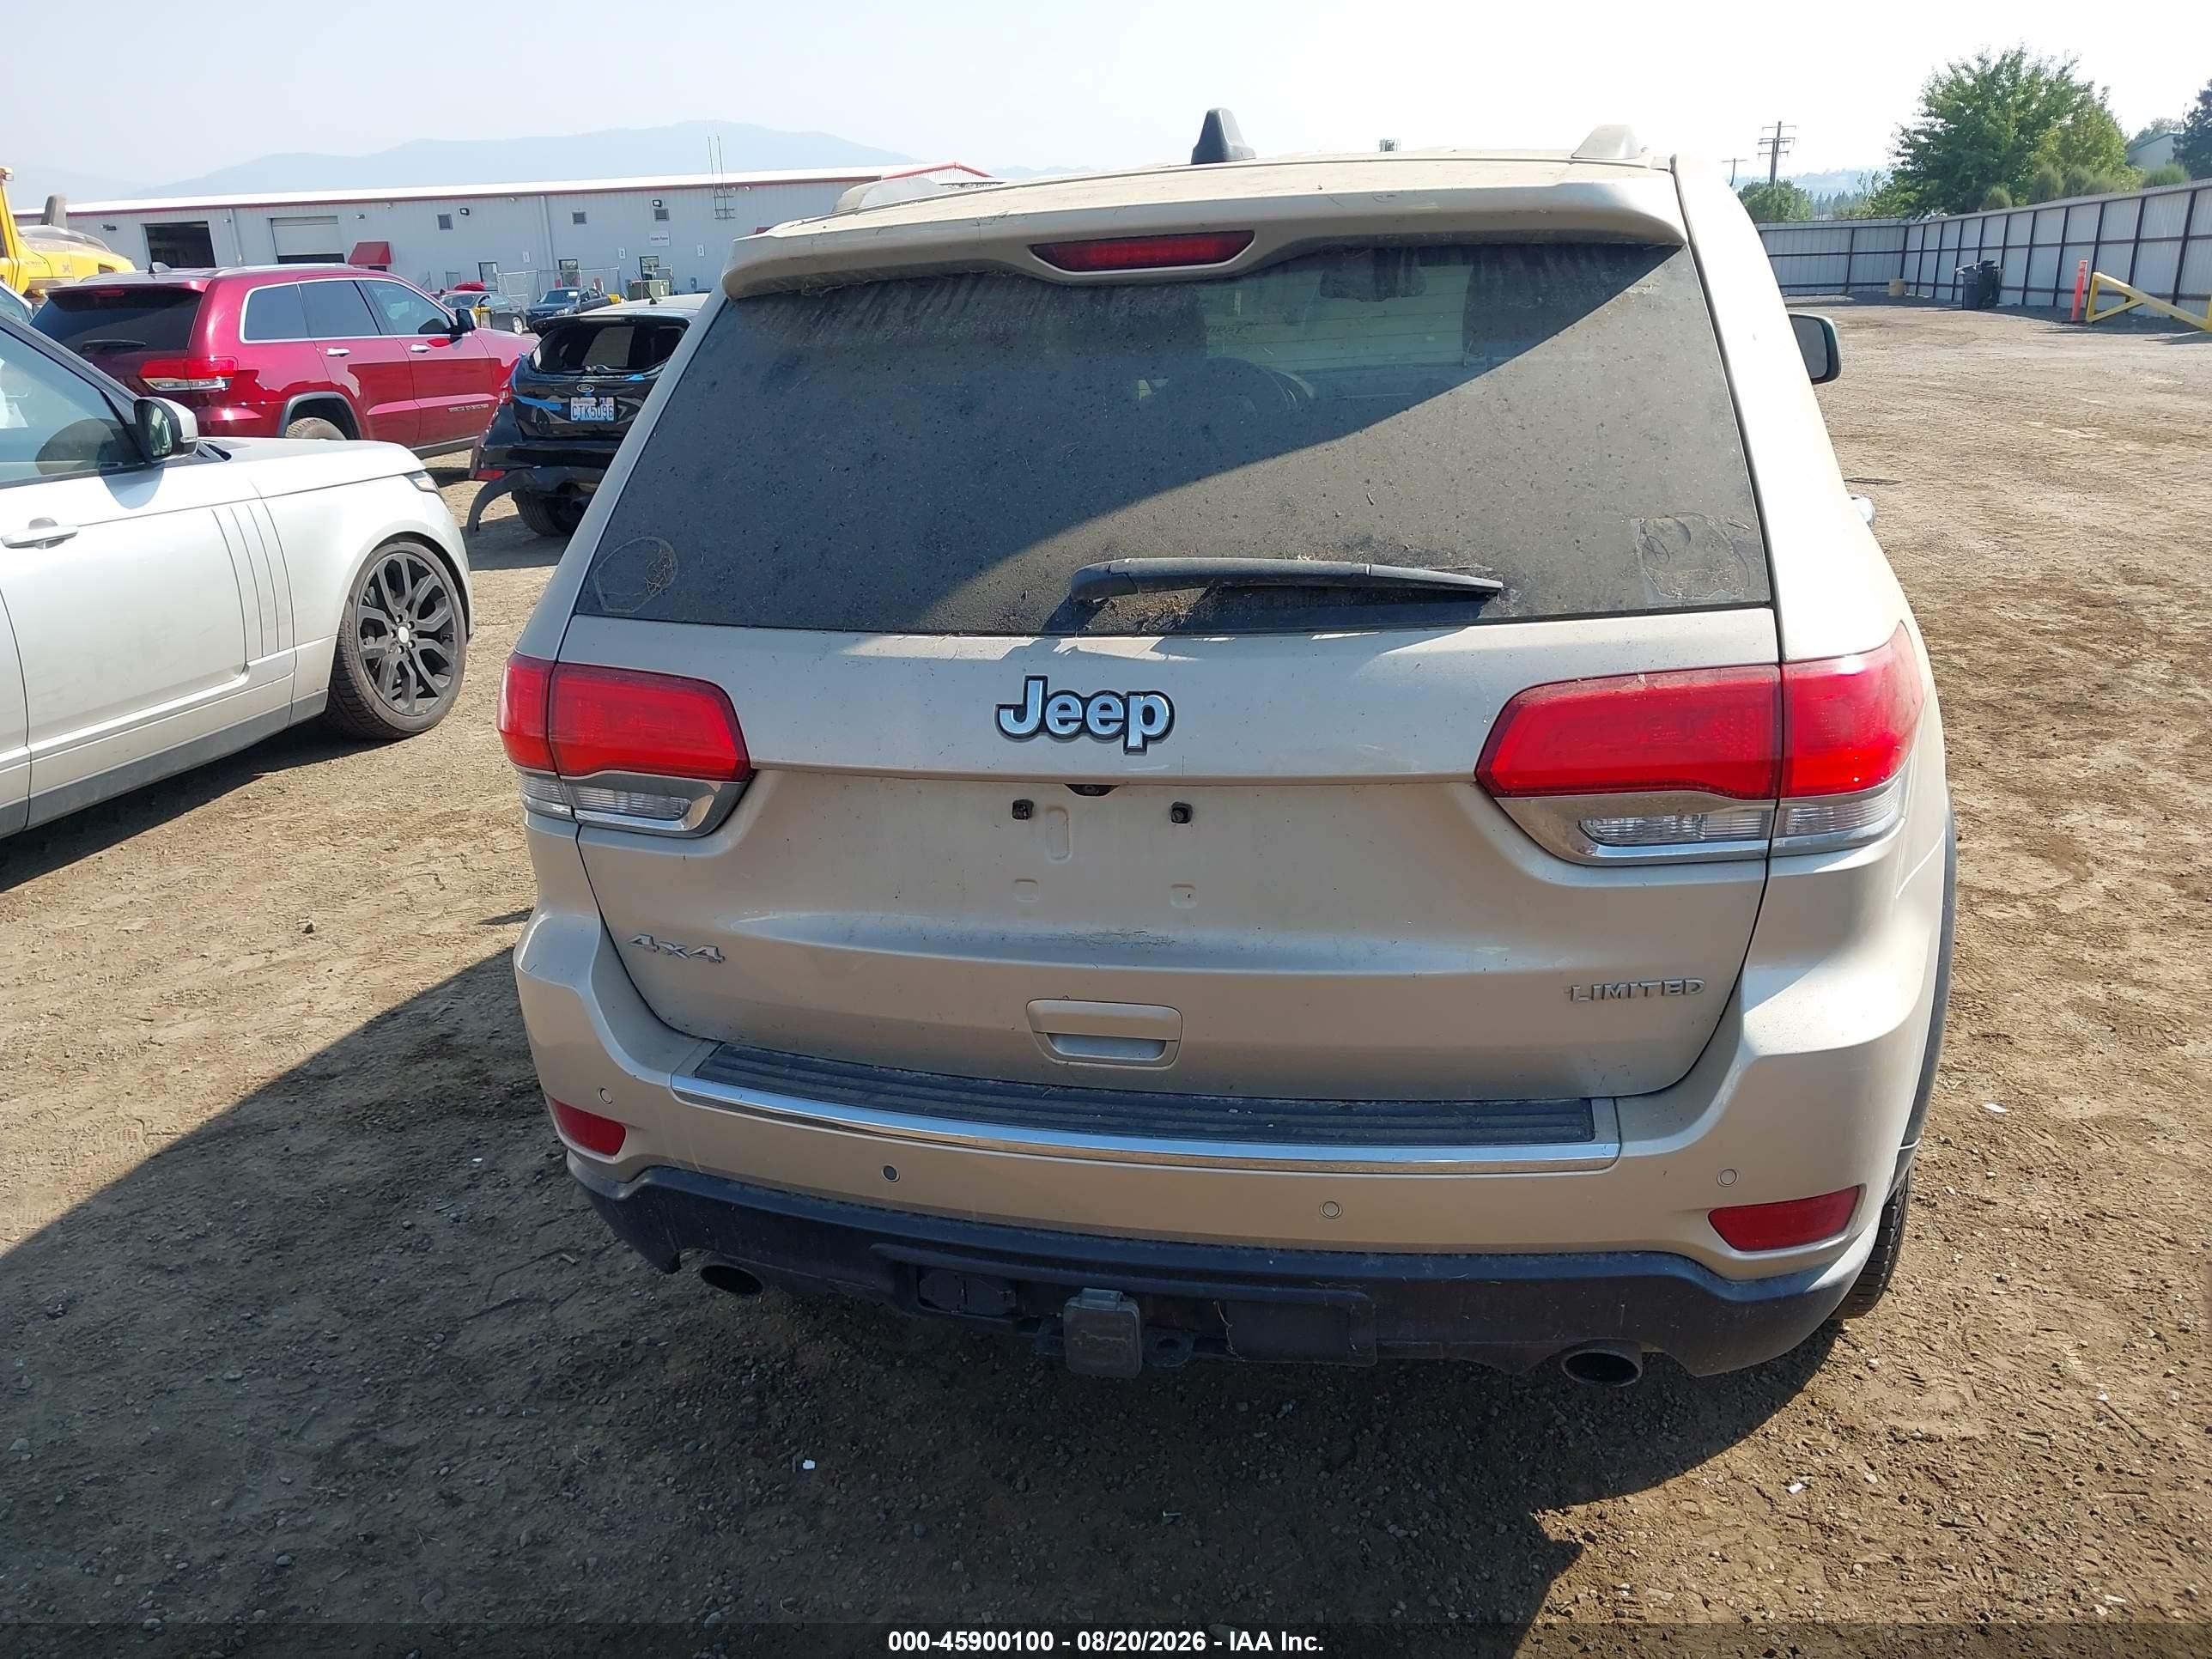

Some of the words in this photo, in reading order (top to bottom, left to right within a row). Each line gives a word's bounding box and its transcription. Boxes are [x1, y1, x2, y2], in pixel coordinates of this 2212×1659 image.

[572, 405, 613, 418] CTK5096
[995, 676, 1174, 754] Jeep
[628, 933, 726, 963] 4x4
[1570, 977, 1706, 1003] LIMITED
